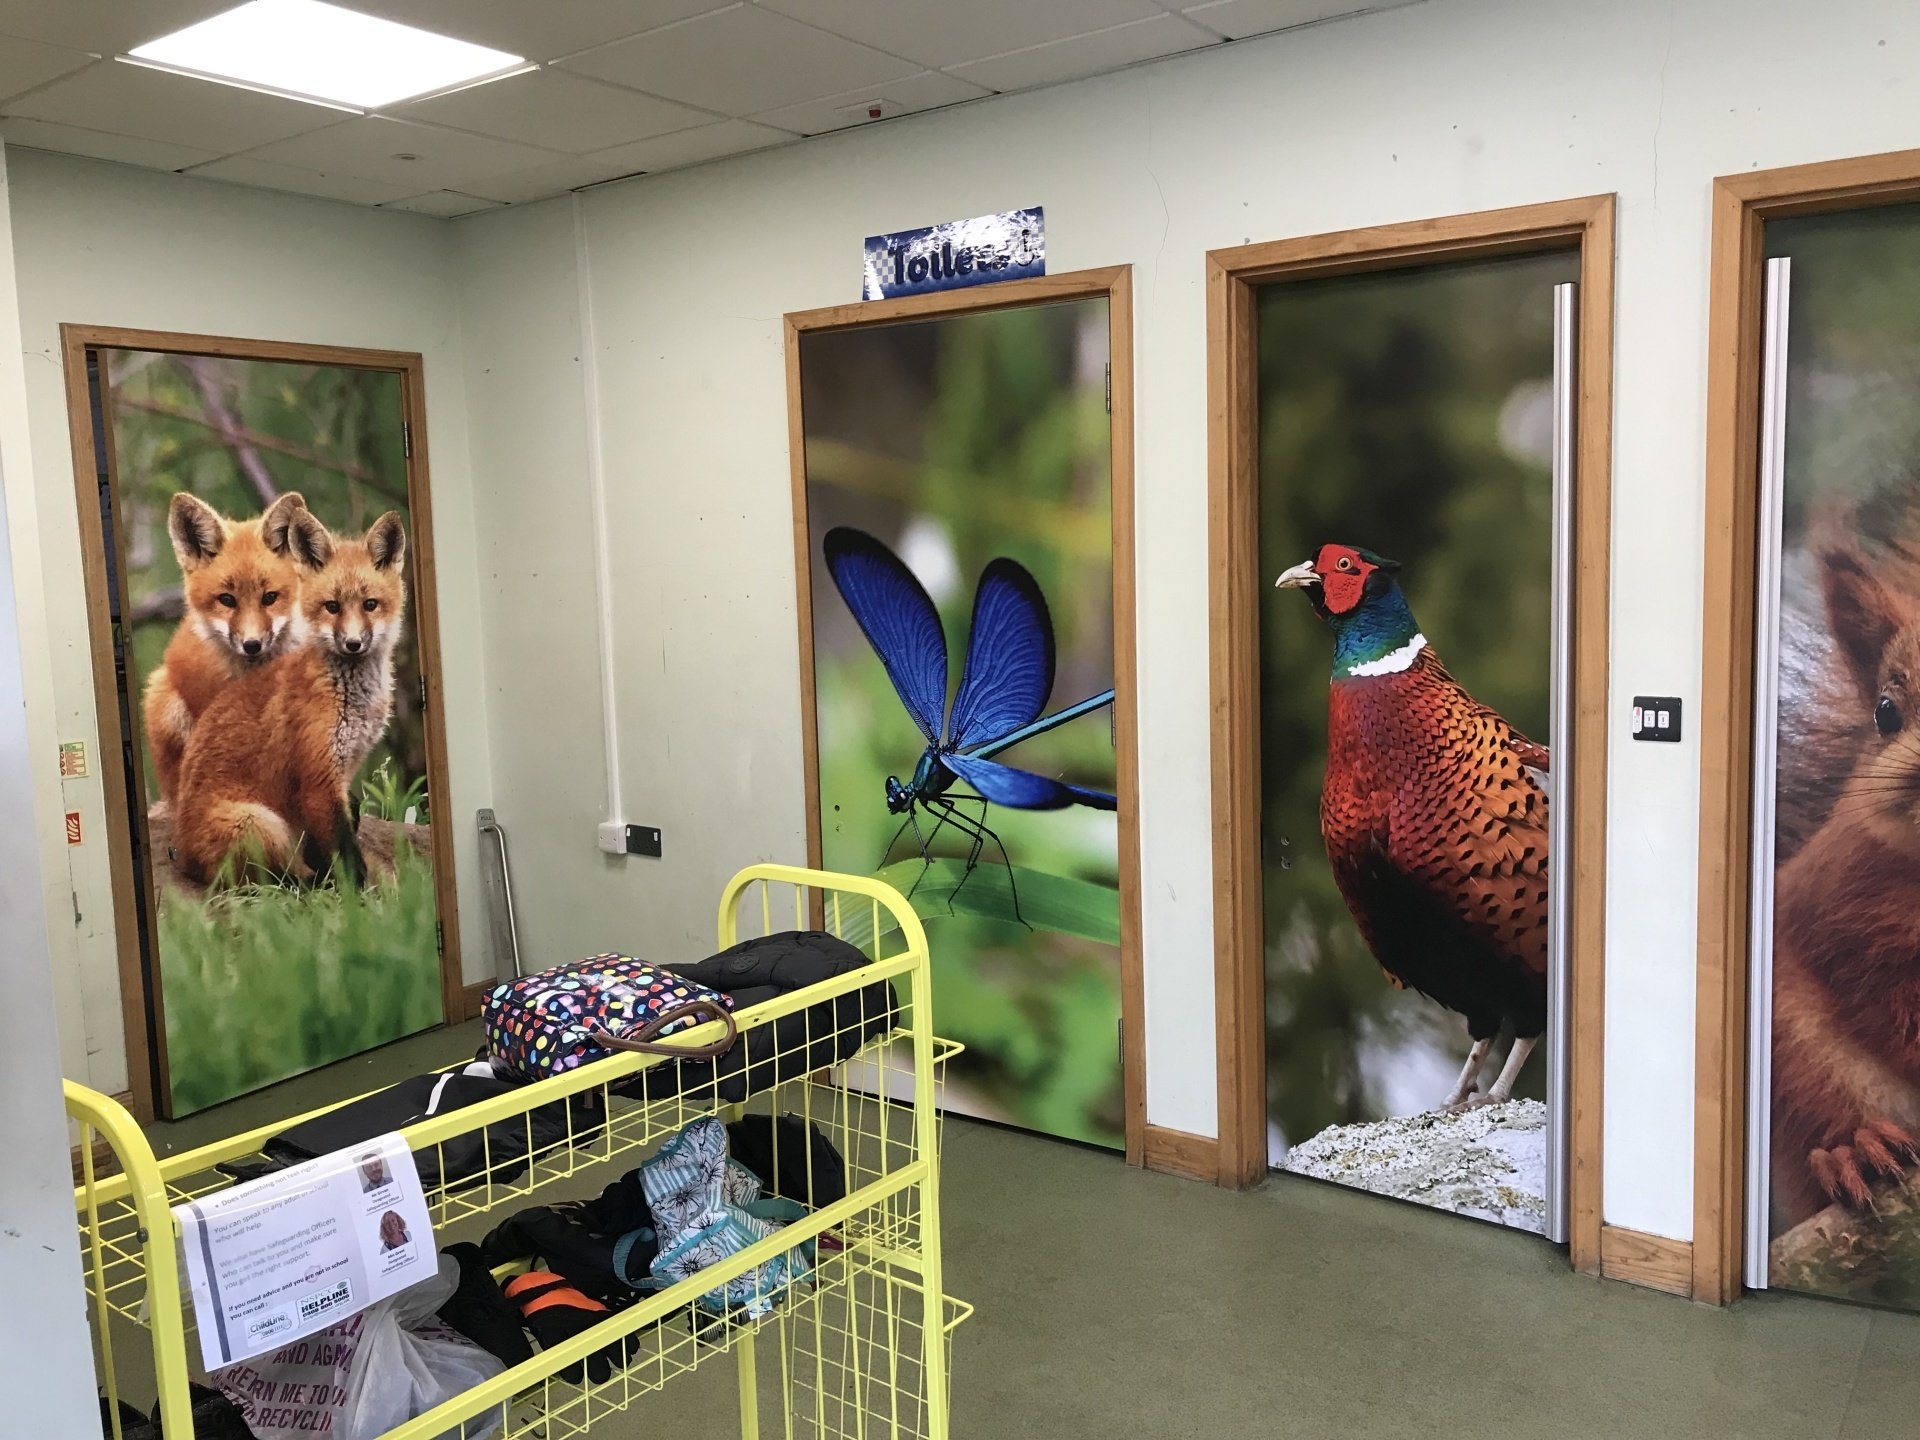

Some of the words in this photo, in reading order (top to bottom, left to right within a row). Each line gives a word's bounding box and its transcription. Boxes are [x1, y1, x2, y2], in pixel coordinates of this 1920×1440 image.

[221, 1195, 239, 1207] Does
[240, 1181, 275, 1199] something
[275, 1175, 287, 1184] not
[214, 1224, 228, 1234] You
[229, 1219, 241, 1229] can
[242, 1211, 261, 1224] speak
[271, 1202, 283, 1211] any
[215, 1232, 232, 1244] who
[233, 1227, 245, 1238] will
[248, 1246, 265, 1257] have
[267, 1229, 310, 1249] Safeguarding
[311, 1216, 336, 1232] Officers
[222, 1269, 238, 1280] who
[252, 1257, 266, 1268] talk
[267, 1254, 275, 1262] to
[276, 1248, 289, 1259] you
[290, 1240, 303, 1252] and
[304, 1233, 321, 1247] make
[323, 1228, 337, 1238] sure
[224, 1280, 238, 1291] you
[251, 1268, 265, 1279] the
[265, 1260, 281, 1273] right
[228, 1304, 234, 1312] If
[234, 1301, 246, 1310] you
[246, 1295, 262, 1305] need
[263, 1287, 281, 1299] advice
[281, 1282, 293, 1291] and
[293, 1277, 304, 1286] you
[305, 1272, 315, 1281] are
[315, 1267, 325, 1276] not
[331, 1257, 349, 1269] school
[230, 1311, 242, 1321] you
[243, 1307, 254, 1316] can
[301, 1287, 349, 1313] HELPLINE
[250, 1314, 285, 1333] ChildLine
[272, 1342, 309, 1364] AND
[279, 1383, 307, 1404] ME
[308, 1384, 329, 1405] TO
